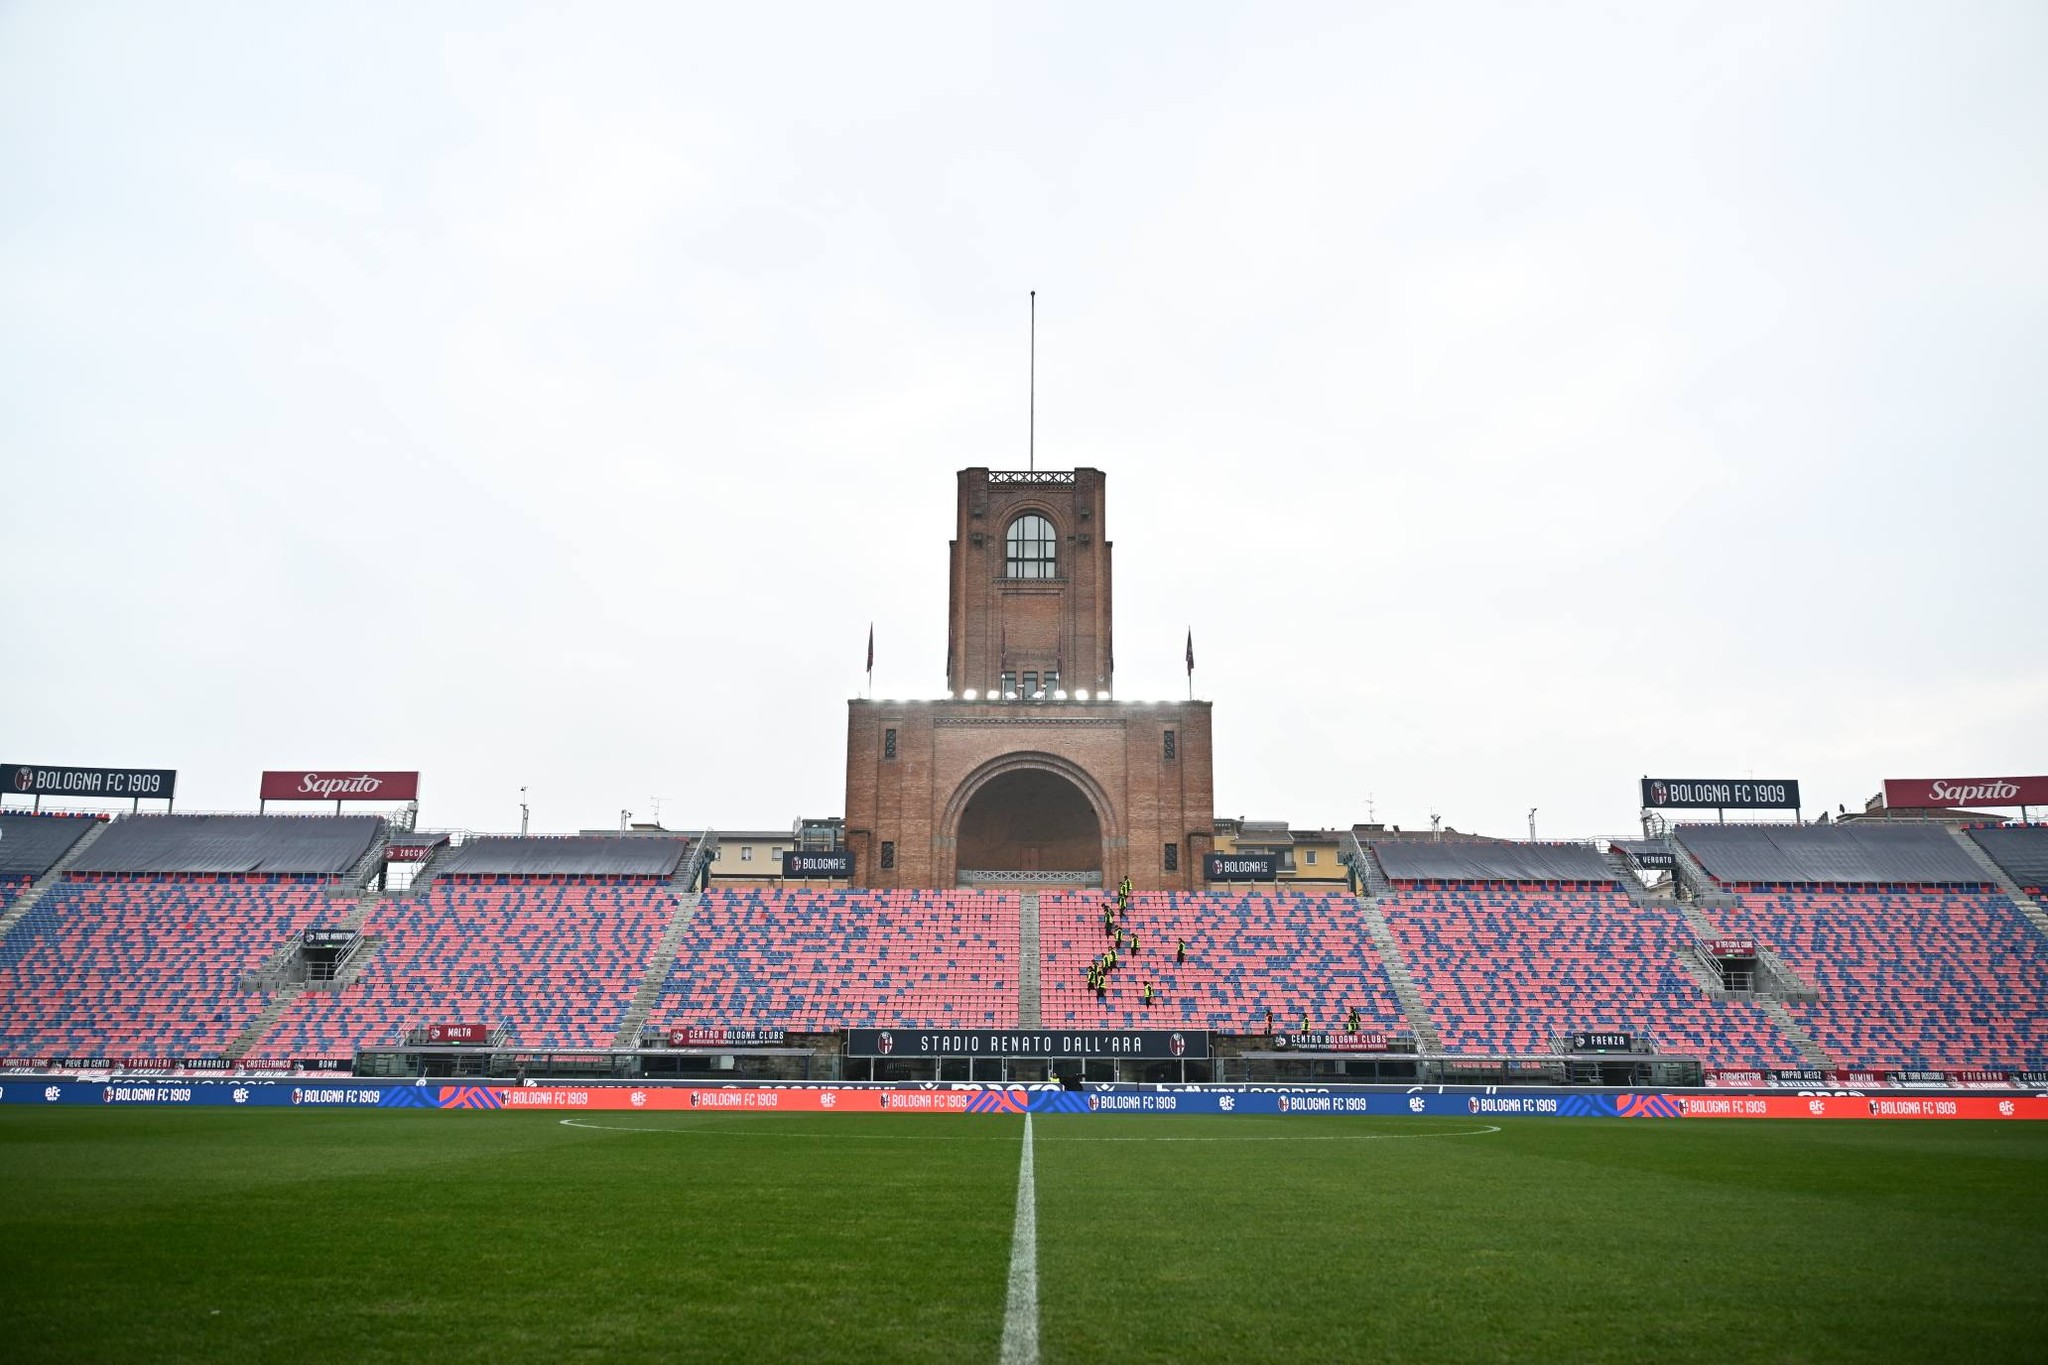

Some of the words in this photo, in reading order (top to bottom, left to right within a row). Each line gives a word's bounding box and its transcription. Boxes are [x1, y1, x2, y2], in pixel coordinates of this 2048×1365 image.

[36, 771, 102, 791] BOLOGNA
[106, 773, 124, 792] FC
[128, 774, 160, 793] 1909
[298, 774, 383, 798] Saputo
[1671, 784, 1730, 802] BOLOGNA
[1735, 785, 1750, 802] FC
[1754, 786, 1785, 803] 1909
[1929, 781, 2020, 806] Saputo
[803, 858, 838, 870] BOLOGNA
[1224, 862, 1260, 872] BOLOGNA
[448, 1028, 472, 1037] MALTA
[689, 1031, 719, 1039] CENTRO
[723, 1031, 755, 1039] BOLOGNA
[759, 1032, 784, 1040] CLUBS
[922, 1036, 978, 1051] STADIO
[991, 1037, 1051, 1052] RENATO
[1064, 1036, 1141, 1052] DALL'ARA
[1292, 1035, 1321, 1044] CENTRO
[1326, 1035, 1358, 1044] BOLOGNA
[1362, 1036, 1386, 1044] CLUBS
[1591, 1036, 1624, 1045] FAENZA
[65, 1059, 82, 1068] PIEVE
[83, 1060, 89, 1068] DI
[91, 1059, 110, 1068] CENTO
[128, 1060, 171, 1068] TRANVIERI
[188, 1060, 230, 1068] GRANAROLO
[247, 1060, 291, 1068] CASTELFRANCO
[1781, 1071, 1802, 1079] ARPAD
[1804, 1071, 1822, 1079] WEISZ
[1963, 1072, 2003, 1080] FRIGNANO
[116, 1088, 155, 1101] BOLOGNA
[158, 1088, 168, 1101] FC
[170, 1088, 191, 1101] 1909
[304, 1090, 344, 1103] BOLOGNA
[346, 1090, 358, 1103] FC
[360, 1090, 380, 1103] 1909
[513, 1092, 552, 1104] BOLOGNA
[555, 1092, 566, 1104] FC
[568, 1092, 588, 1104] 1909
[702, 1093, 741, 1106] BOLOGNA
[744, 1093, 754, 1106] FC
[758, 1093, 777, 1106] 1909
[892, 1095, 931, 1107] BOLOGNA
[934, 1095, 944, 1107] FC
[947, 1095, 967, 1107] 1909
[1101, 1097, 1140, 1109] BOLOGNA
[1143, 1097, 1154, 1109] FC
[1156, 1097, 1176, 1109] 1909
[1291, 1098, 1330, 1110] BOLOGNA
[1333, 1098, 1344, 1110] FC
[1346, 1098, 1366, 1110] 1909
[1481, 1099, 1521, 1112] BOLOGNA
[1524, 1099, 1534, 1112] FC
[1536, 1099, 1556, 1112] 1909
[1691, 1101, 1730, 1114] BOLOGNA
[1733, 1101, 1743, 1114] FC
[1746, 1101, 1766, 1114] 1909
[1881, 1102, 1920, 1114] BOLOGNA
[1923, 1102, 1933, 1114] FC
[1936, 1102, 1956, 1114] 1909
